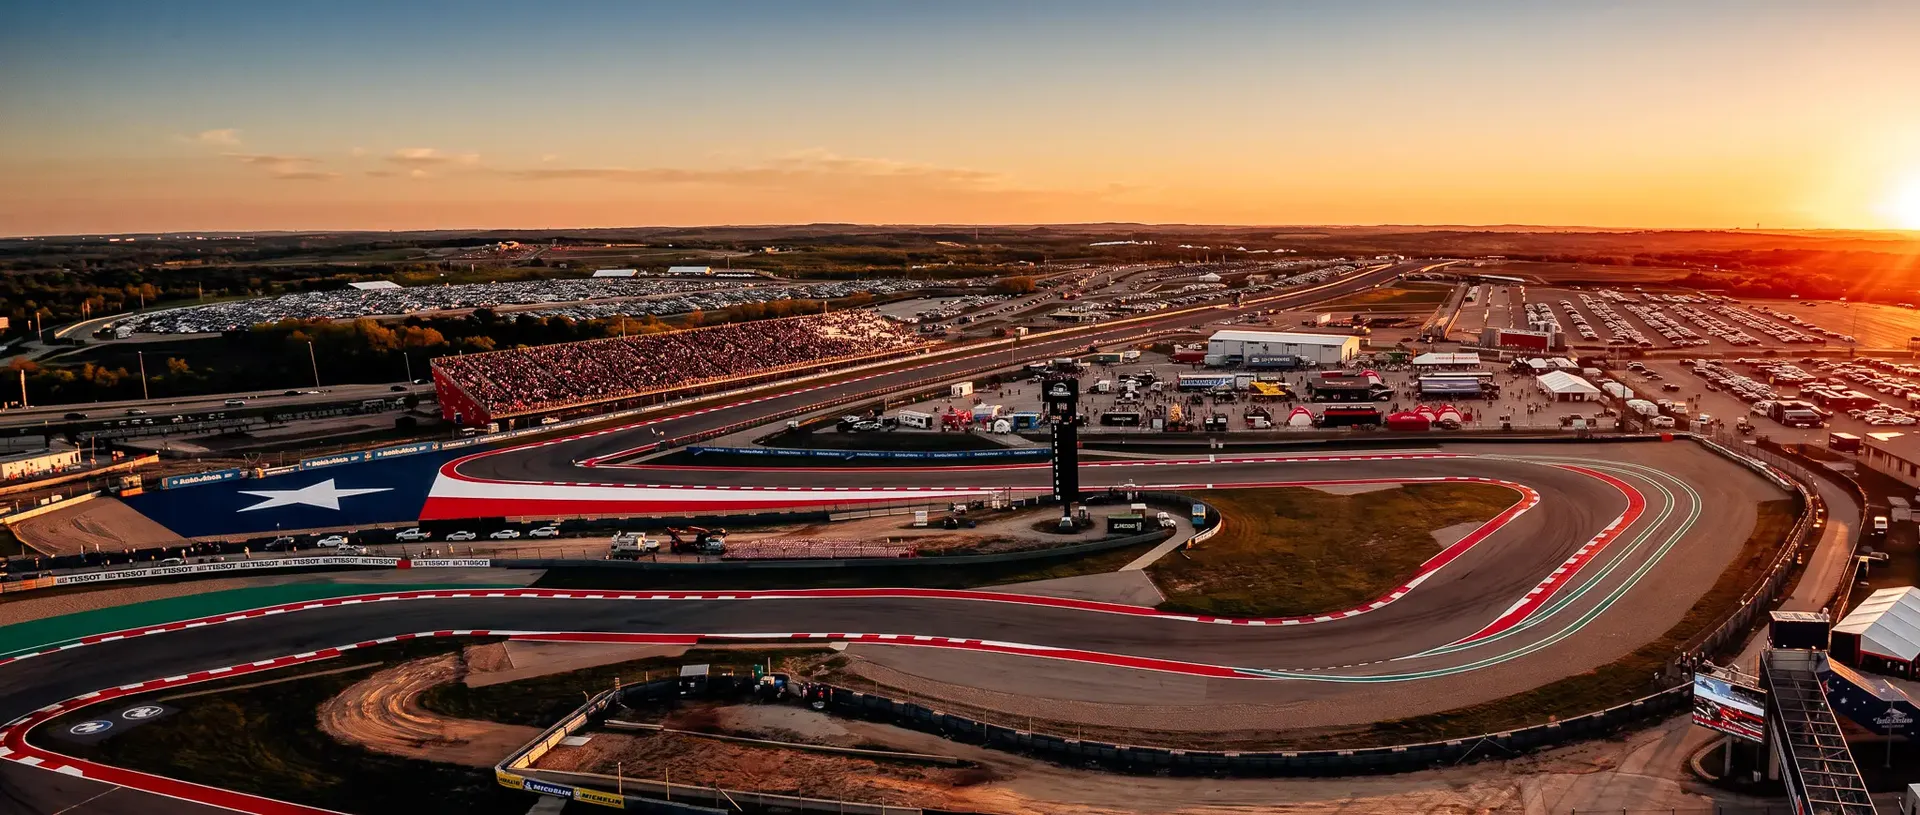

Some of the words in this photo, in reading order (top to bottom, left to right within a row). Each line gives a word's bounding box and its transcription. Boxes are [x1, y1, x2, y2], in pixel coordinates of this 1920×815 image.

[68, 574, 101, 583] TISSOT
[115, 569, 148, 578] TISSOT
[162, 566, 193, 574] TISSOT
[581, 793, 623, 805] MICHELIN
